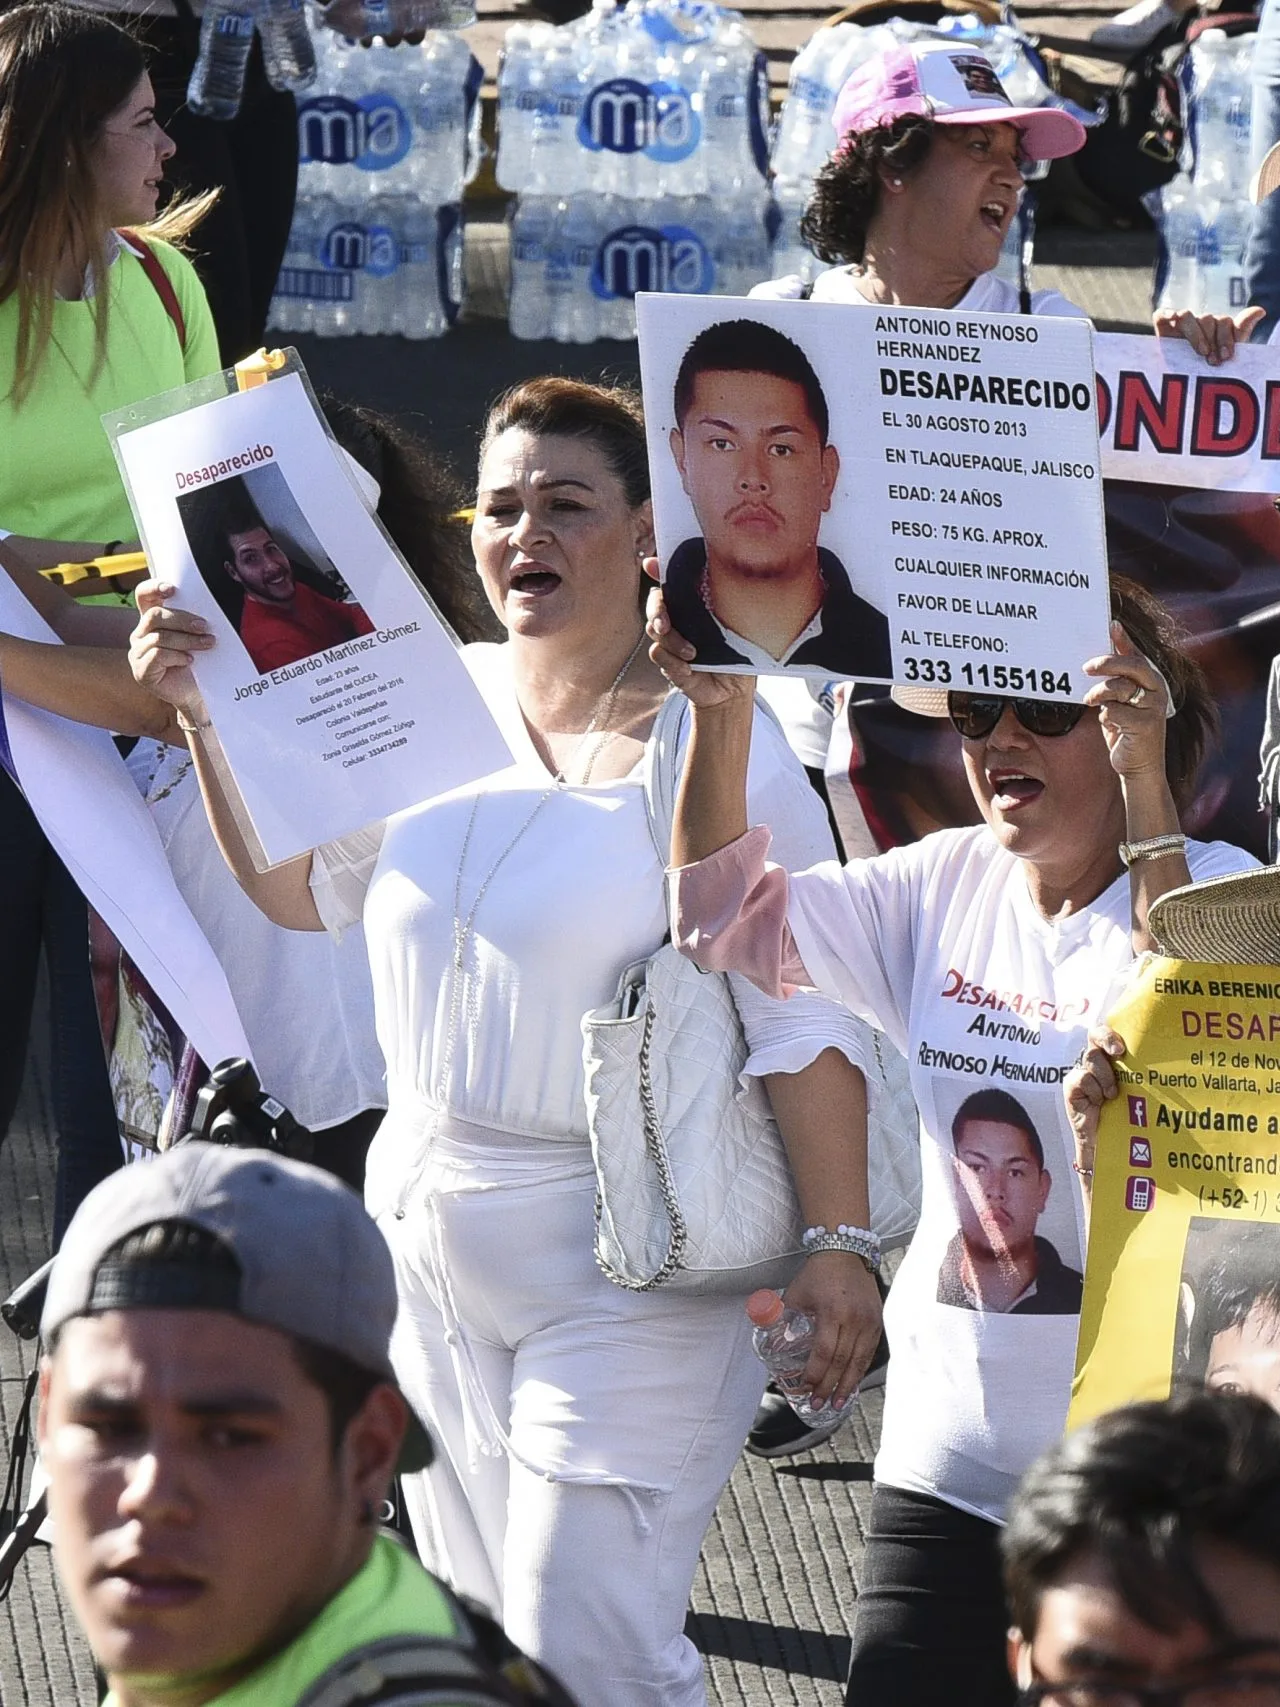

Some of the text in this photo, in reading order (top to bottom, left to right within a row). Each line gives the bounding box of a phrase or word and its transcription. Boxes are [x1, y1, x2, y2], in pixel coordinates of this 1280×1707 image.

[300, 106, 398, 157] mia
[590, 91, 690, 147] mia
[331, 230, 393, 267] mia
[603, 239, 702, 292] mia
[875, 316, 1038, 343] ANTONIO REYNOSO
[877, 340, 981, 363] HERNANDEZ
[880, 368, 1091, 411] DESAPARECIDO
[883, 411, 1027, 437] EL 30 AGOSTO 2013
[175, 443, 274, 489] Desaparecido
[885, 448, 1095, 479] EN TLAQUEPAQUE, JALISCO
[888, 484, 1002, 508] EDAD: 24 AÑOS
[891, 520, 1048, 549] PESO: 75 KG. APROX.
[894, 557, 1090, 589] CUALQUIER INFORMACIÓN
[897, 593, 1038, 620] FAVOR DE LLAMAR
[900, 630, 1009, 653] AL TELEFONO:
[234, 677, 269, 702] Jorge
[270, 657, 323, 685] Eduardo
[376, 620, 421, 644] Gómez
[903, 657, 1072, 695] 333 1155184
[309, 672, 379, 704] Estudiante del CUCEA
[295, 704, 337, 725] Desapareció
[343, 697, 352, 706] 20
[352, 689, 377, 703] Febrero
[377, 683, 388, 693] del
[325, 714, 351, 728] Colonia
[335, 719, 377, 740] Comunicarse
[341, 737, 369, 753] Griselda
[369, 728, 393, 742] Gómez
[1154, 977, 1205, 996] ERIKA
[967, 1013, 1041, 1046] ANTONIO
[918, 1040, 988, 1075] REYNOSO
[1190, 1052, 1203, 1066] el
[1209, 1051, 1226, 1067] 12
[1231, 1053, 1250, 1069] de
[1149, 1070, 1198, 1088] Puerto
[1202, 1073, 1261, 1095] Vallarta,
[1156, 1103, 1258, 1134] Ayudame
[1266, 1114, 1279, 1135] a
[1198, 1184, 1267, 1213] (+52-1)
